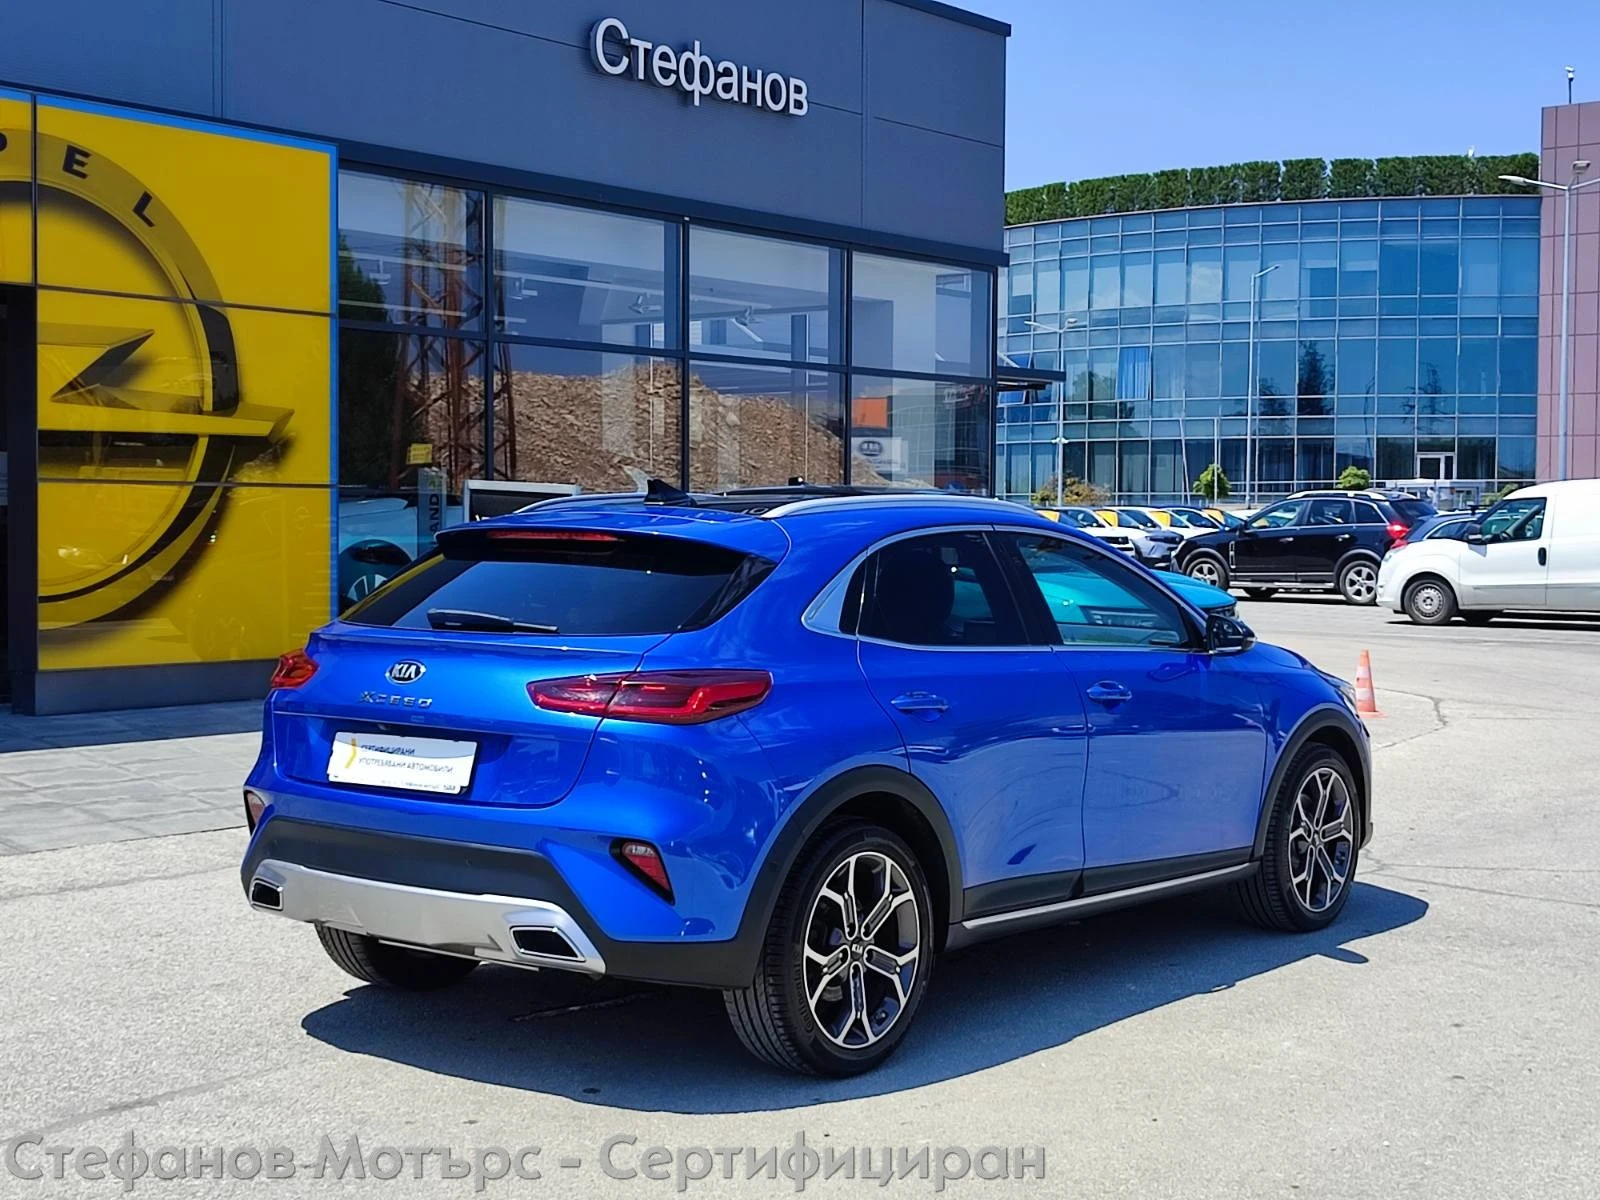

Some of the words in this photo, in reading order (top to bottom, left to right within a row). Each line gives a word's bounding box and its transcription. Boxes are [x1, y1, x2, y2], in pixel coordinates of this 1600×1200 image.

[594, 17, 809, 116] Стефанов
[0, 132, 155, 228] EL
[428, 493, 440, 533] AND
[391, 663, 417, 679] KIA
